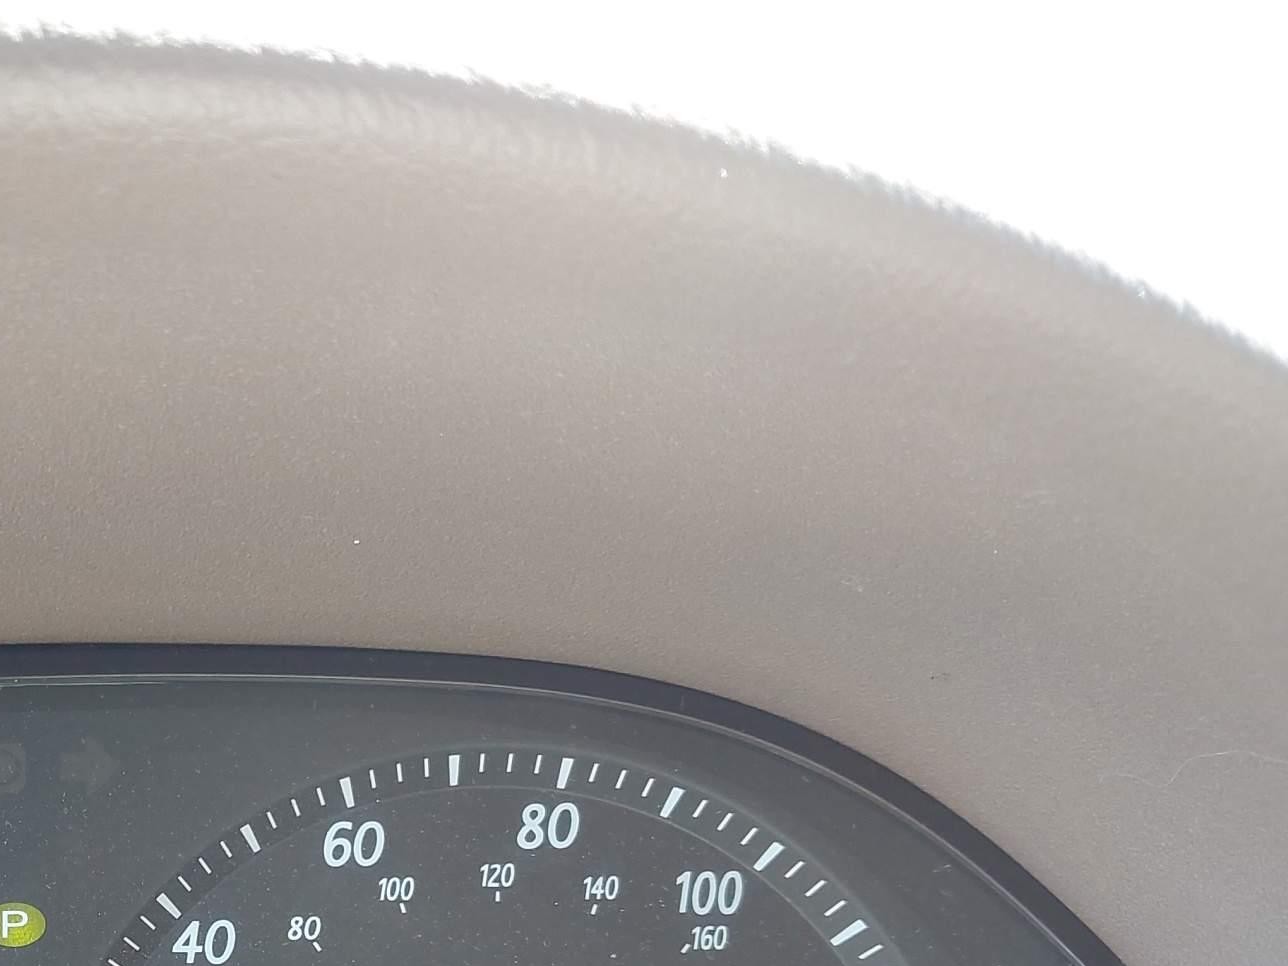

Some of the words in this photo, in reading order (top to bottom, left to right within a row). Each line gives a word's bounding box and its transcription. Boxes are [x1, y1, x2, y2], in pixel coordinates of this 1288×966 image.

[516, 803, 579, 849] 80
[323, 821, 384, 866] 60
[378, 877, 413, 901] 100
[480, 864, 514, 888] 120
[583, 876, 618, 900] 140
[676, 871, 742, 915] 100
[2, 910, 28, 938] P
[288, 917, 321, 940] 80
[172, 920, 235, 964] 40
[692, 926, 726, 950] 160
